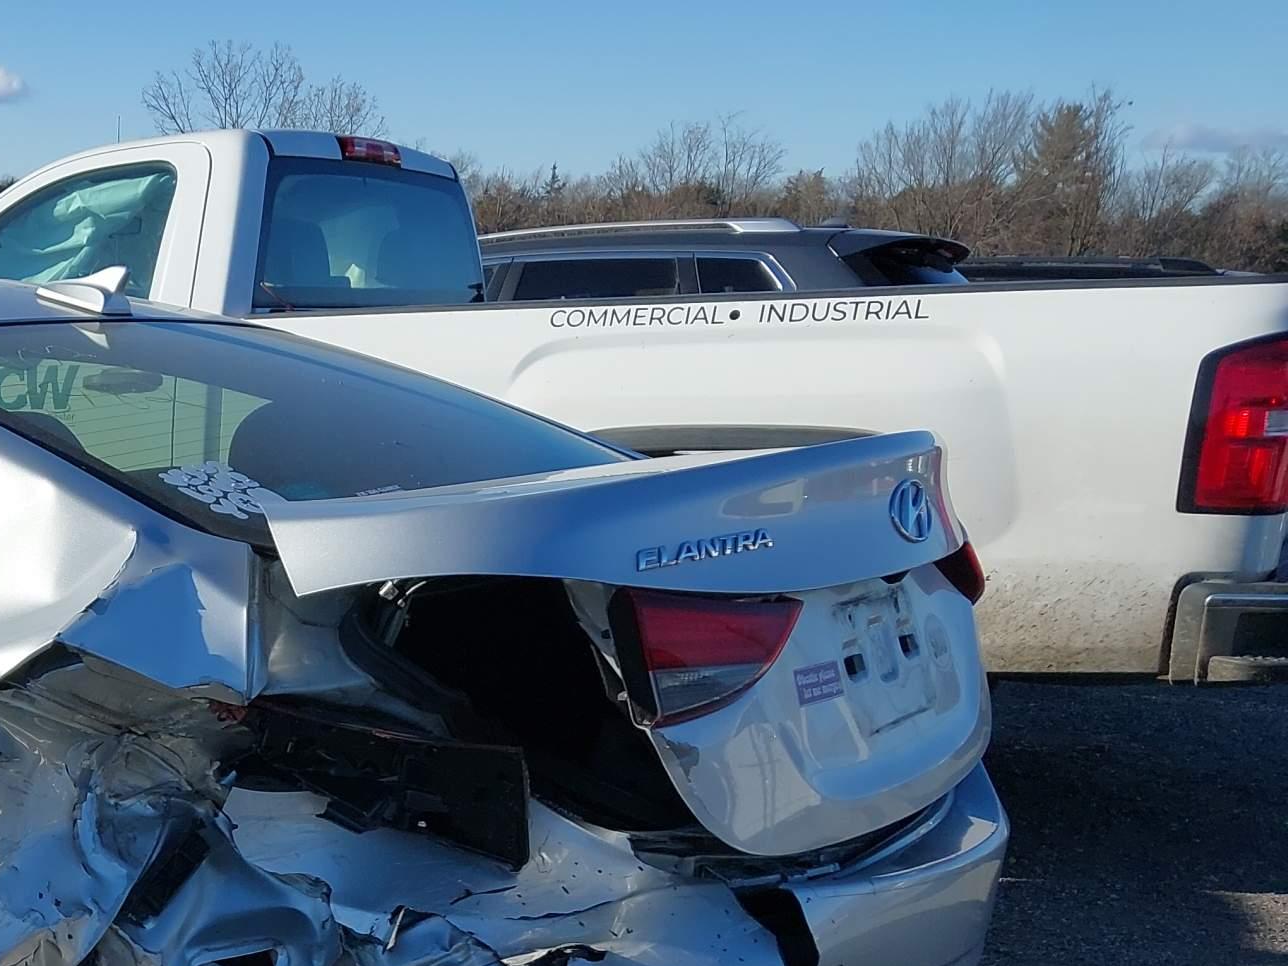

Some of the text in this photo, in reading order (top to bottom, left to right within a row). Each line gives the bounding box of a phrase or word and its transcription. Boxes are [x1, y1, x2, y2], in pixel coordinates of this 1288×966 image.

[550, 300, 929, 328] COMMERCIAL INDUSTRIAL
[636, 528, 774, 572] ELANTRA
